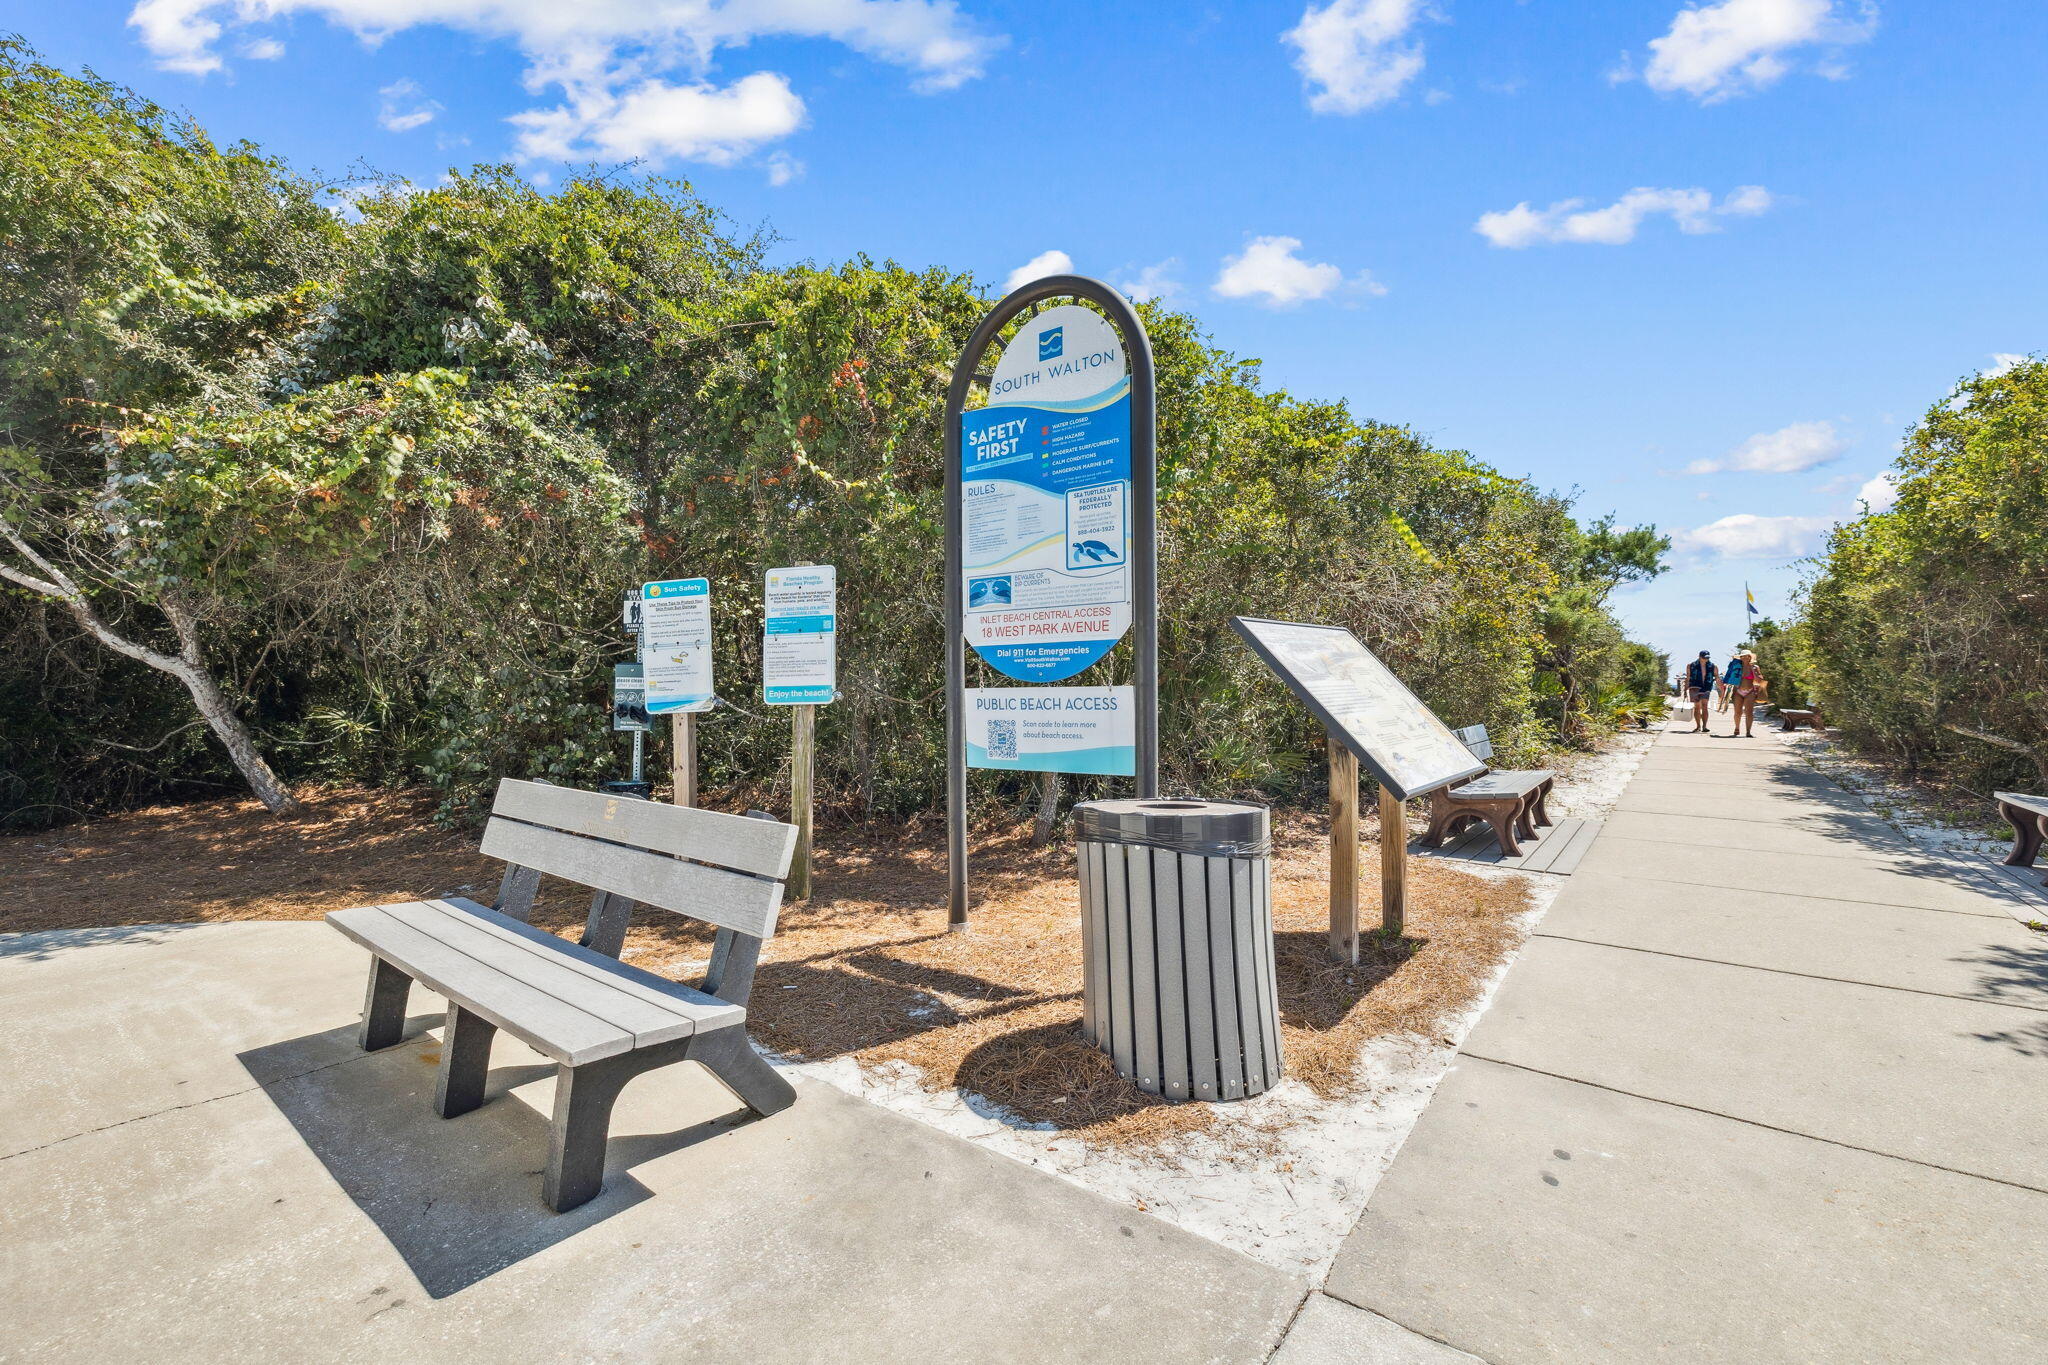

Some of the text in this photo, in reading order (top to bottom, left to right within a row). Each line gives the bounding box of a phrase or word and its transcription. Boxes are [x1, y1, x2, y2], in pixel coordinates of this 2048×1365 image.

[994, 349, 1114, 395] SOUTH WALTON
[1051, 421, 1069, 430] WATER
[1069, 416, 1089, 425] CLOSED
[968, 417, 1028, 447] SAFETY
[1064, 431, 1085, 440] HAZARD
[977, 437, 1019, 462] FIRST
[1051, 447, 1078, 457] MODERATE
[1051, 452, 1097, 466] CALM CONDITIONS
[1051, 458, 1114, 476] DANGEROUS MARINE LIFE
[967, 483, 996, 498] RULES
[1073, 491, 1083, 499] SEA
[1084, 487, 1106, 497] TURTLES
[1079, 494, 1112, 504] FEDERALLY
[1079, 501, 1112, 511] PROTECTED
[1014, 573, 1035, 581] BEWARE
[1023, 578, 1051, 587] CURRENTS
[678, 584, 701, 592] Safety
[979, 606, 1112, 624] INLET BEACH CENTRAL ACCESS
[981, 619, 1110, 638] 18 WEST PARK AVENUE
[997, 646, 1090, 658] Dial 911 for Emergencies
[768, 688, 829, 699] Enjoy the beach!
[976, 696, 1118, 711] PUBLIC BEACH ACCESS
[1022, 719, 1037, 728] Scan
[1037, 720, 1053, 728] code
[1061, 720, 1079, 728] learn
[1079, 721, 1097, 729] more
[1022, 731, 1084, 740] about beach access.
